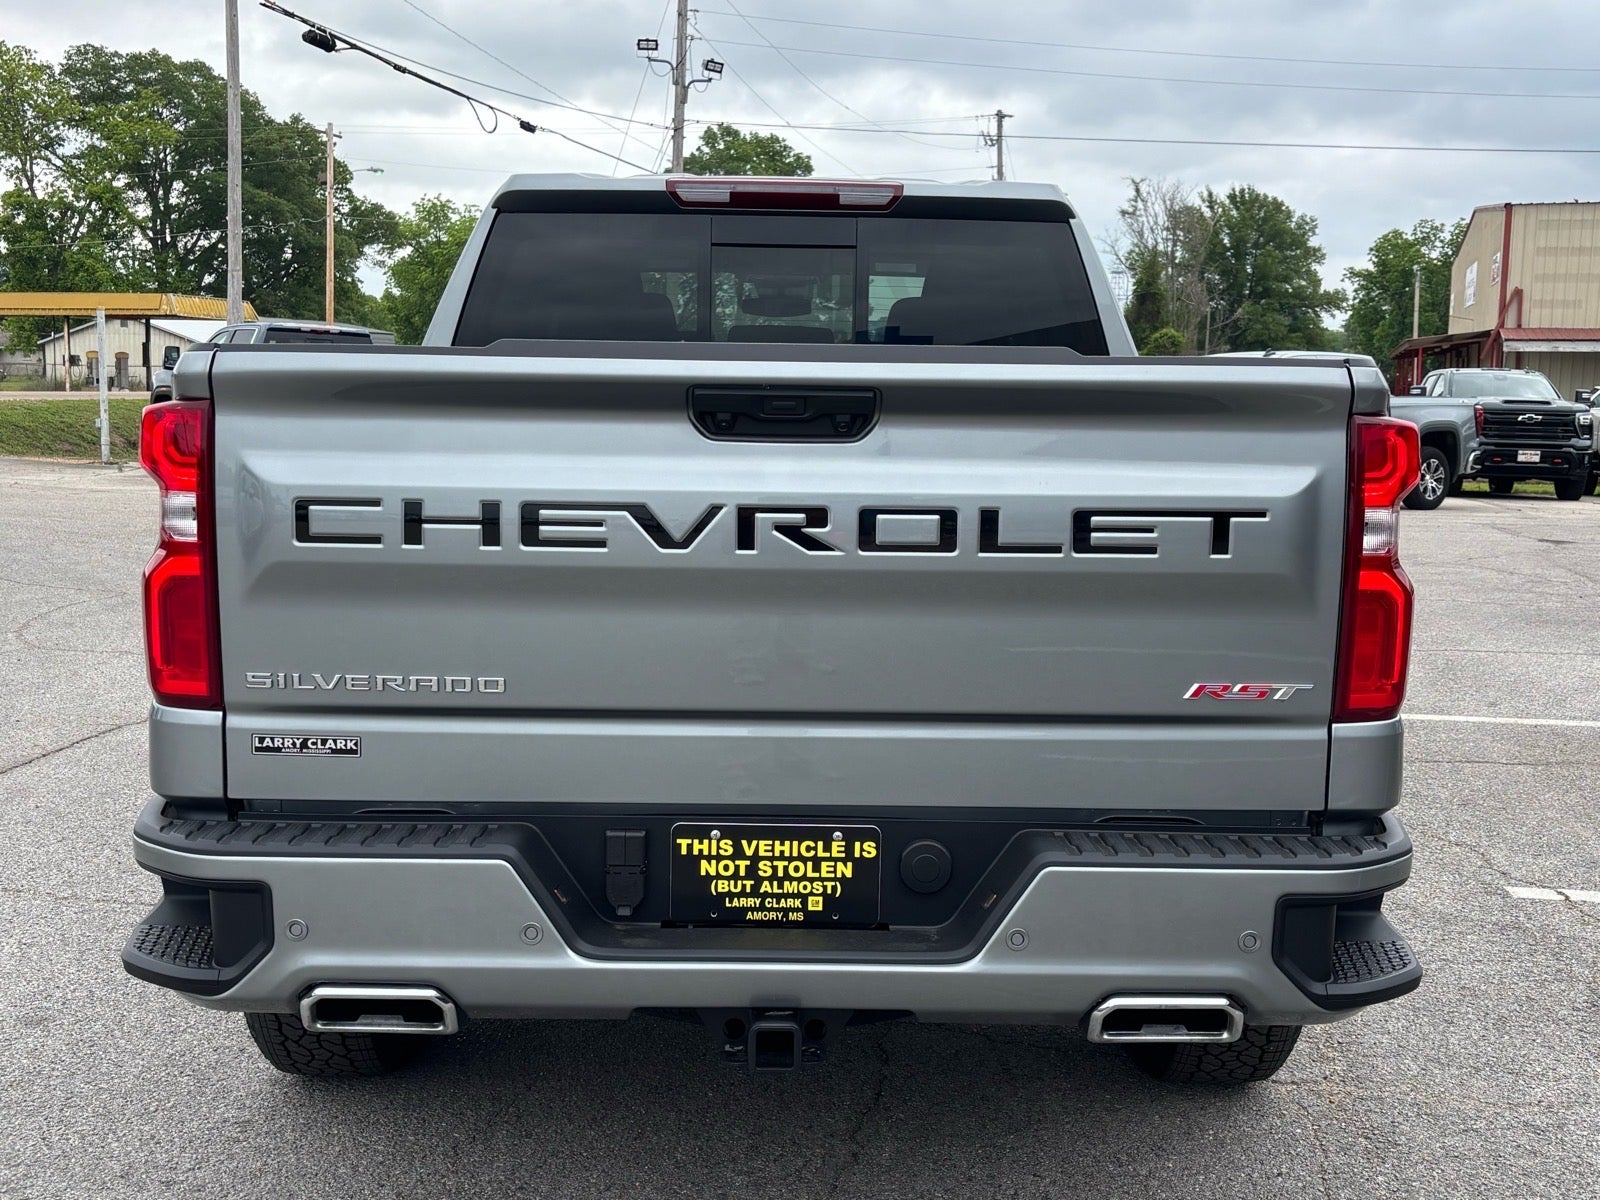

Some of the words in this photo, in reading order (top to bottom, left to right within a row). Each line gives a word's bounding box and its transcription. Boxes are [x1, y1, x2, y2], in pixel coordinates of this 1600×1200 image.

[293, 496, 1270, 558] CHEVROLET
[244, 672, 507, 694] SILVERADO
[1182, 683, 1315, 700] RST
[254, 737, 304, 748] LARRY
[307, 739, 358, 750] CLARK
[676, 838, 733, 856] THIS
[741, 840, 846, 858] VEHICLE
[854, 841, 877, 859] IS
[700, 860, 751, 877] NOT
[757, 860, 853, 878] STOLEN
[710, 879, 754, 896] (BUT
[759, 880, 842, 898] ALMOST)
[725, 897, 761, 908] LARRY
[765, 898, 802, 908] CLARK
[746, 911, 786, 922] AMORY,
[788, 912, 804, 921] MS
